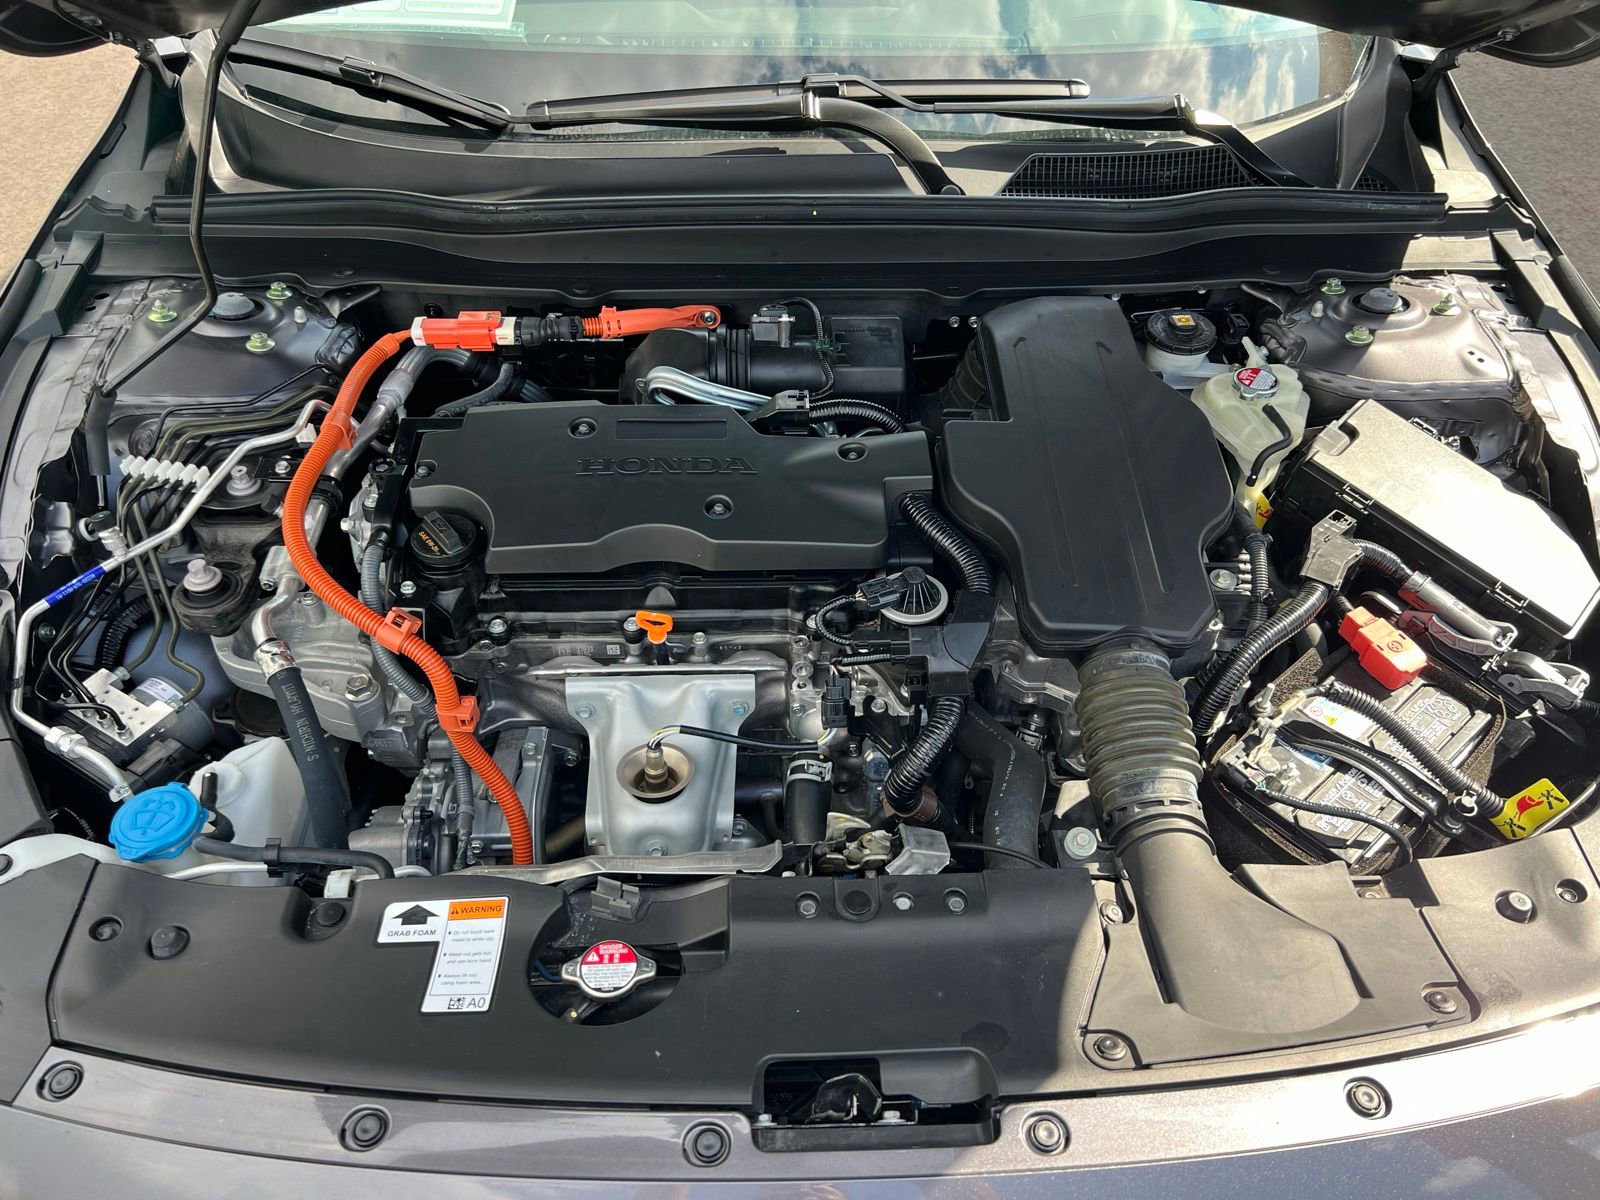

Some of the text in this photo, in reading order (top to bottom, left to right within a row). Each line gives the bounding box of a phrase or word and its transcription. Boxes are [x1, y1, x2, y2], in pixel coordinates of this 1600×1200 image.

[576, 456, 758, 475] HONDA
[461, 905, 502, 914] WARNING
[467, 997, 487, 1009] A0
